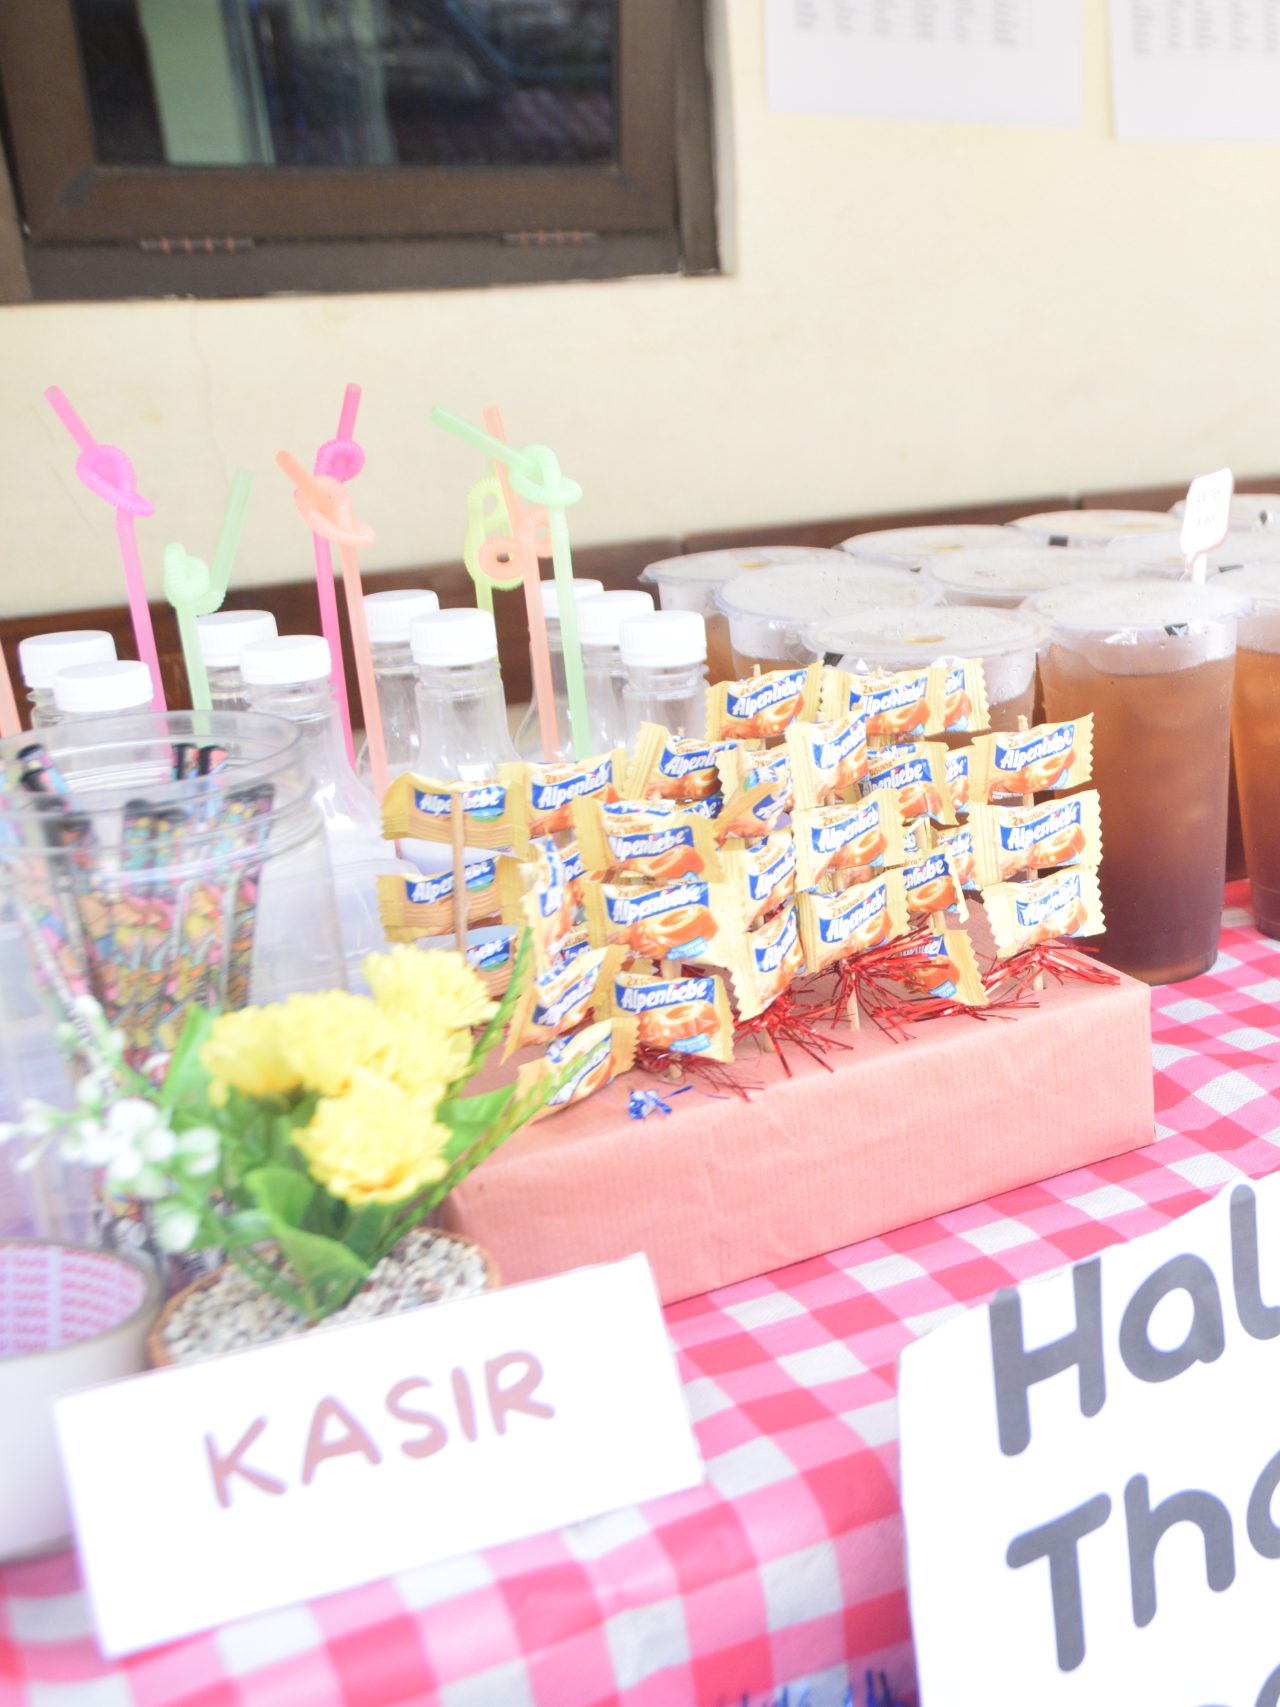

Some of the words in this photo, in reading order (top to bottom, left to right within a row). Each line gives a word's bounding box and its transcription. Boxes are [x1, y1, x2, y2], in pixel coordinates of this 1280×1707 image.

[1000, 728, 1074, 773] Alpenliebe
[621, 979, 708, 1015] Alpenliebe
[203, 1350, 556, 1510] KASIR
